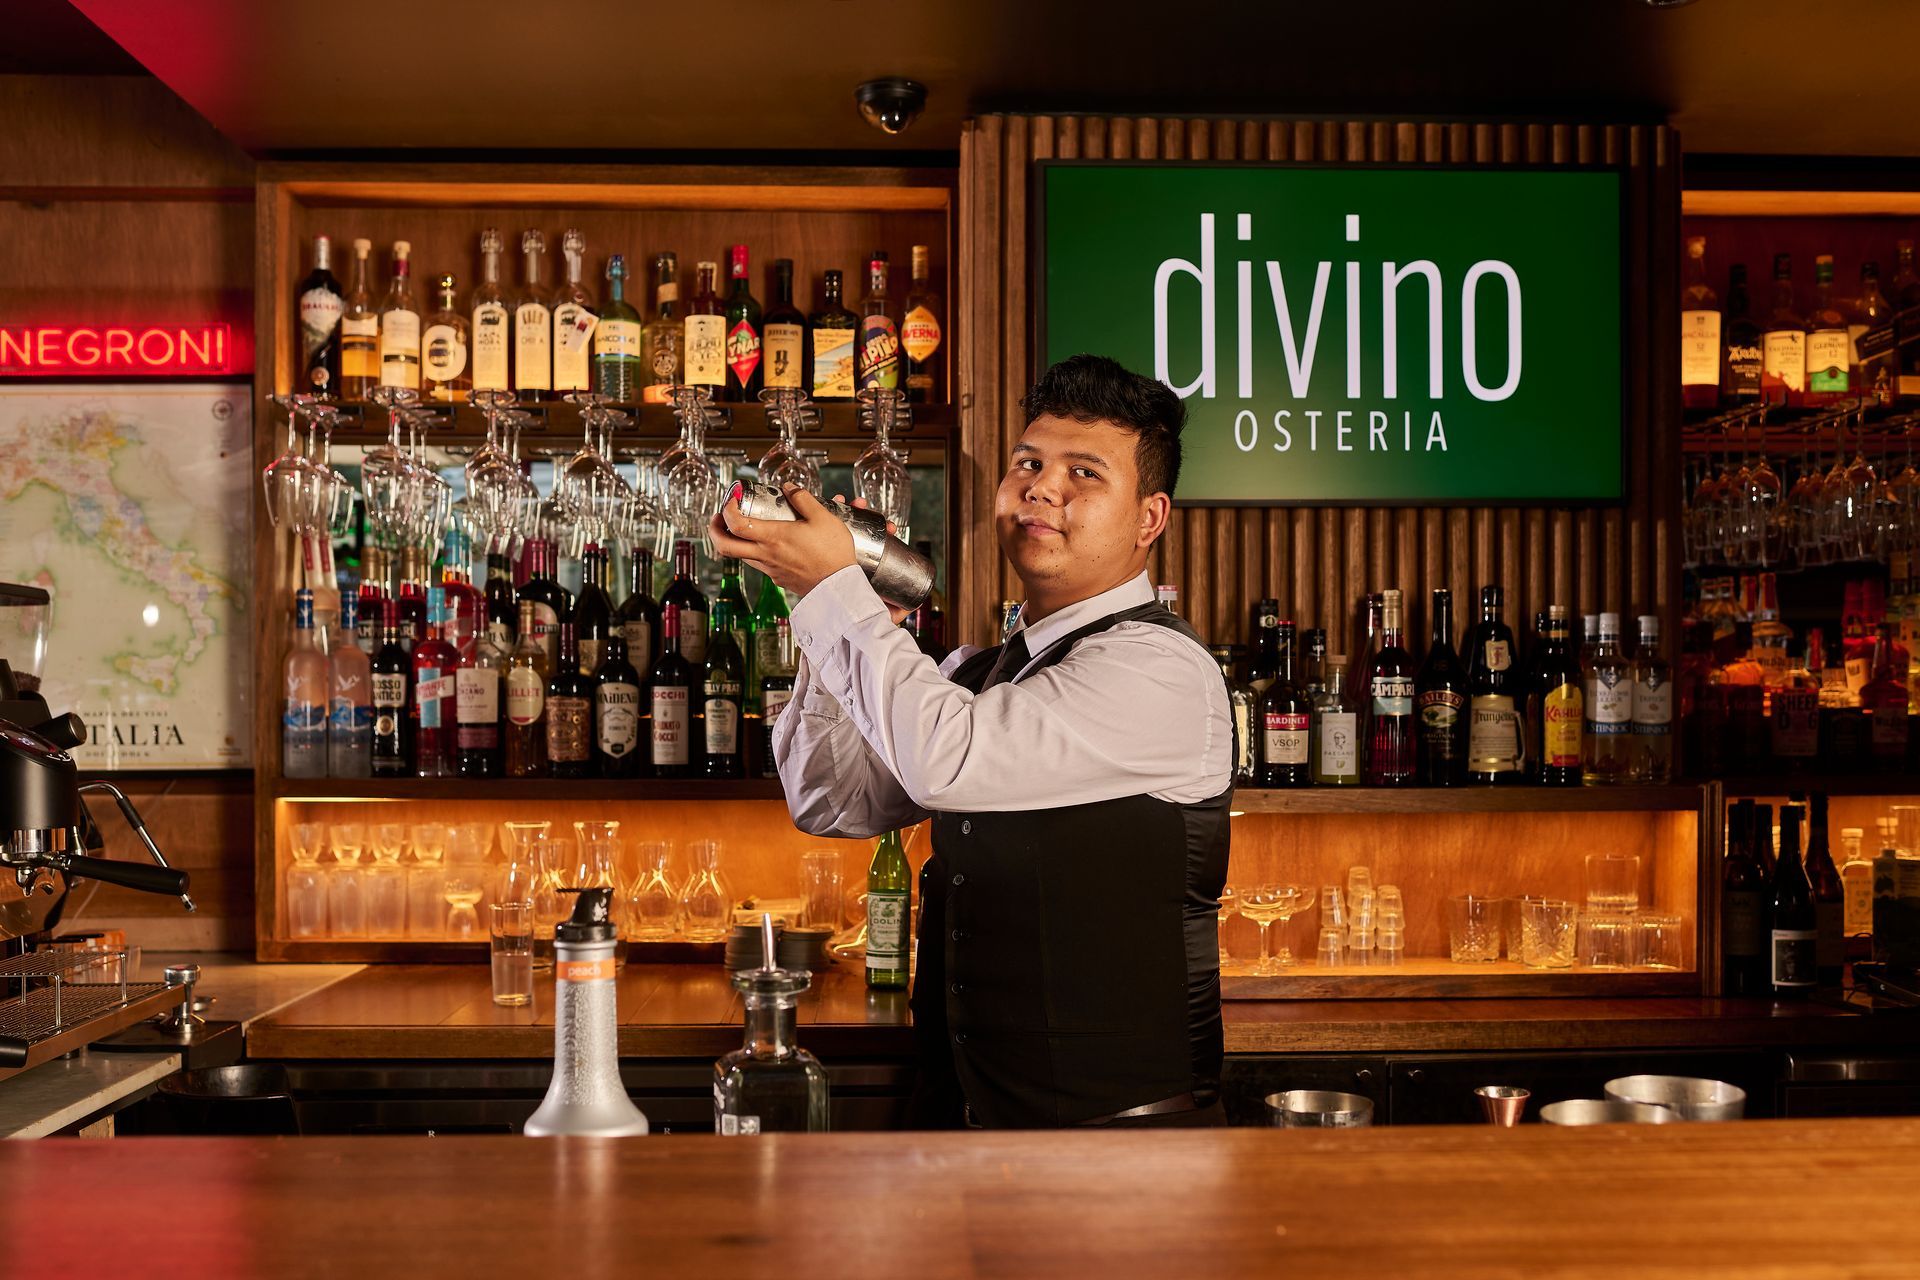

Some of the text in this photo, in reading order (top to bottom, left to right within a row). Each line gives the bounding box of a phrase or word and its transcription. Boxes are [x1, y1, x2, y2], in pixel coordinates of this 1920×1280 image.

[1154, 213, 1522, 401] divino
[0, 329, 224, 366] NEGRONI
[1234, 409, 1448, 451] OSTERIA
[508, 688, 540, 697] LILLET
[1370, 683, 1415, 696] CAMPARI
[1420, 692, 1460, 705] BAILEYS
[1266, 717, 1306, 725] BARDINET
[85, 724, 184, 746] TALIA
[1272, 738, 1300, 748] VSOP
[568, 963, 602, 977] peach
